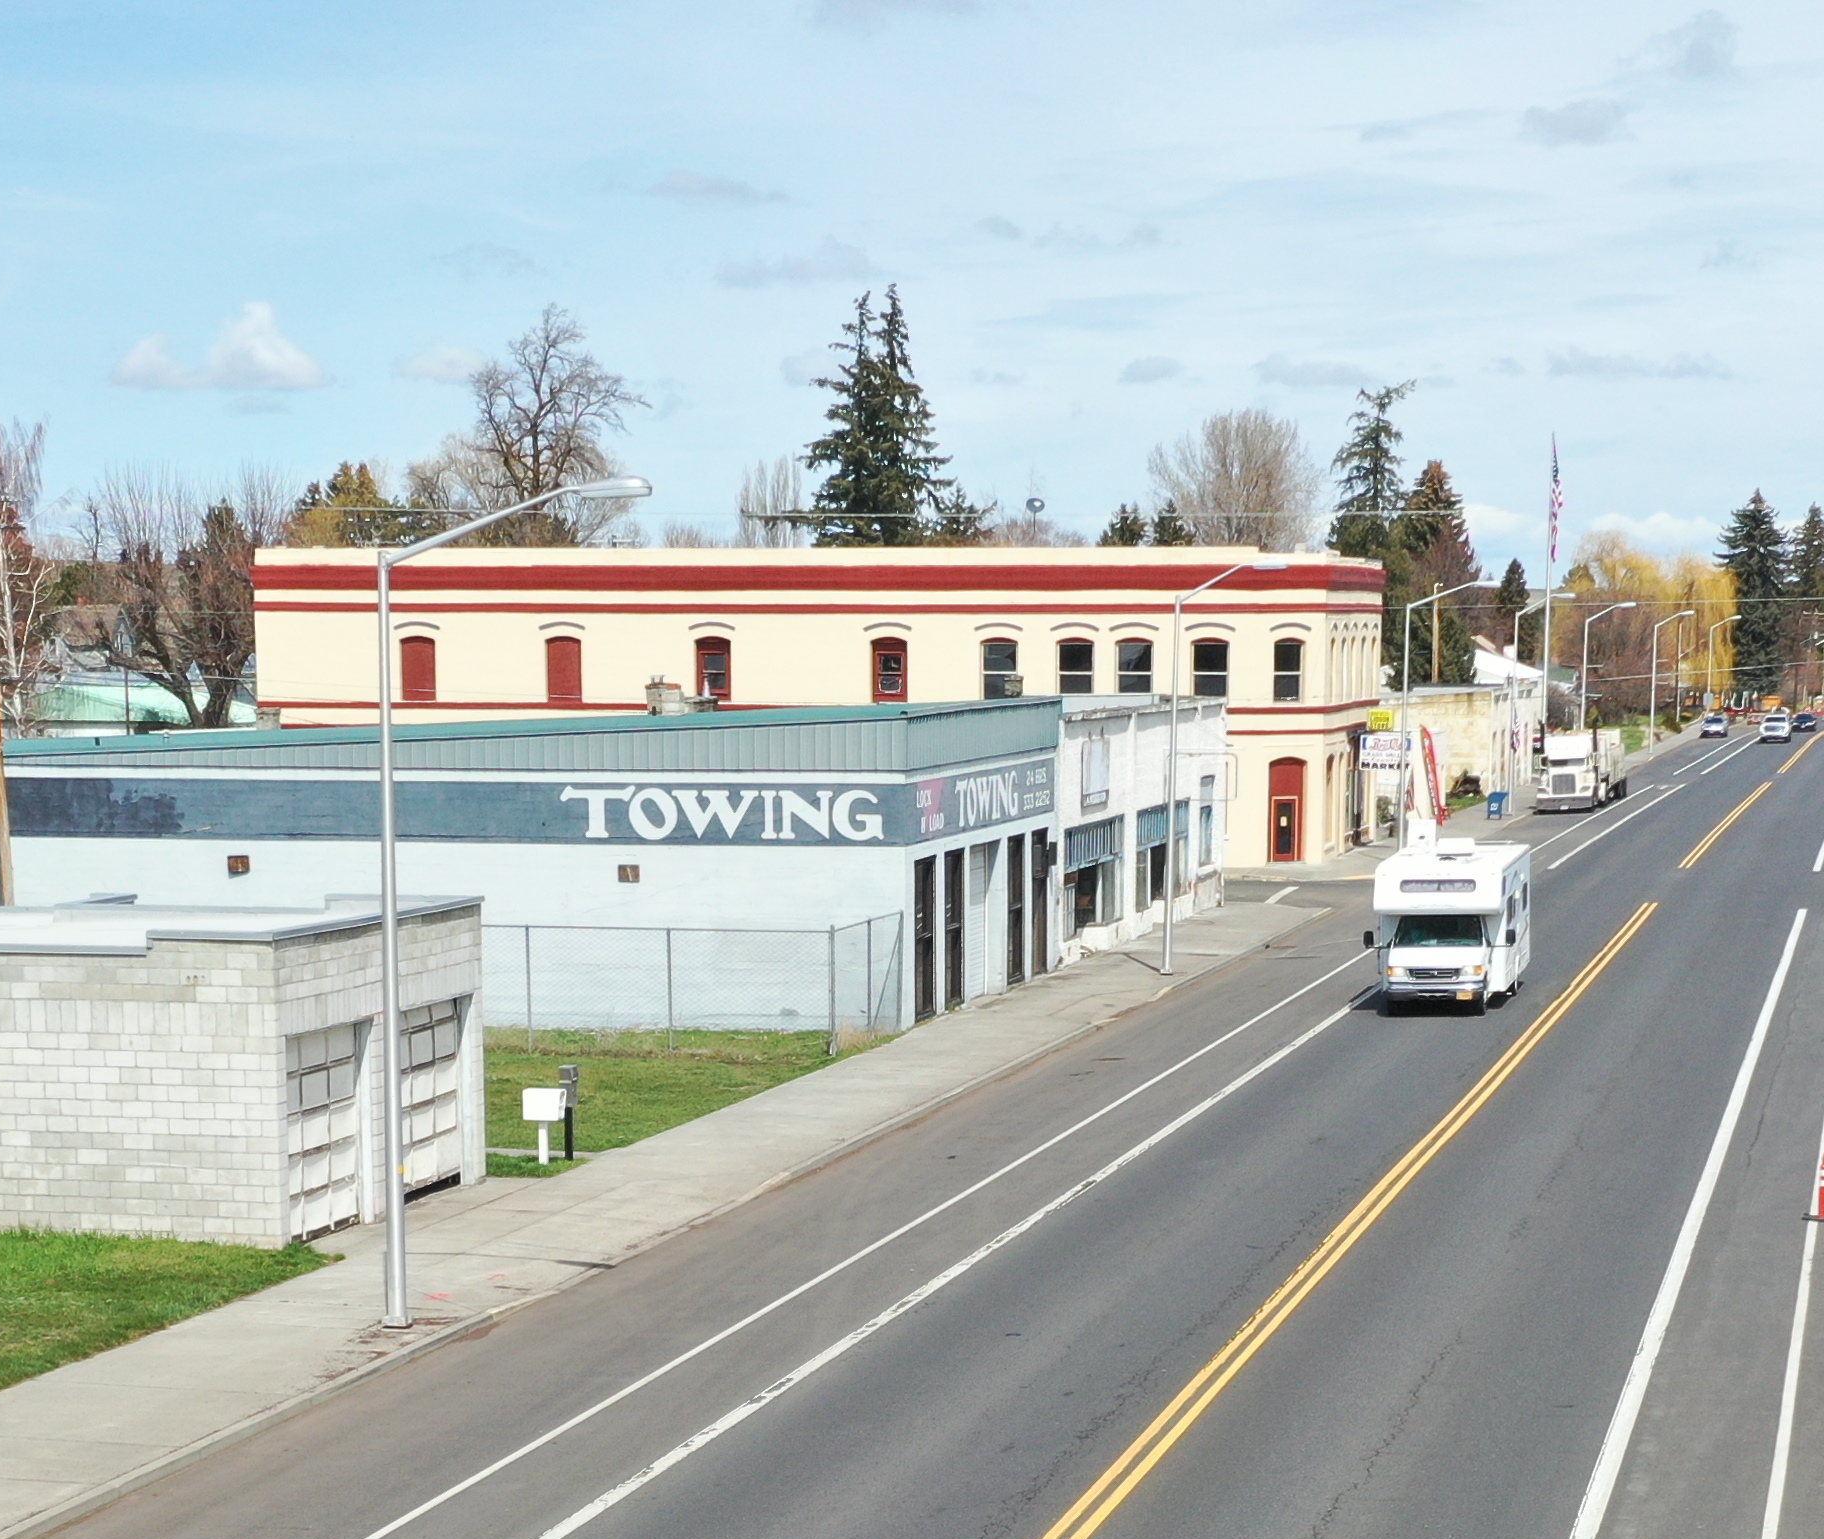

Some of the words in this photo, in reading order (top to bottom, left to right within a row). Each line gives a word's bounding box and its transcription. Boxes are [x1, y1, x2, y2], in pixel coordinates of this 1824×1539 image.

[560, 785, 885, 841] TOWING
[916, 789, 932, 808] LOCK
[954, 770, 1019, 828] TOWING
[929, 812, 945, 831] LOAD
